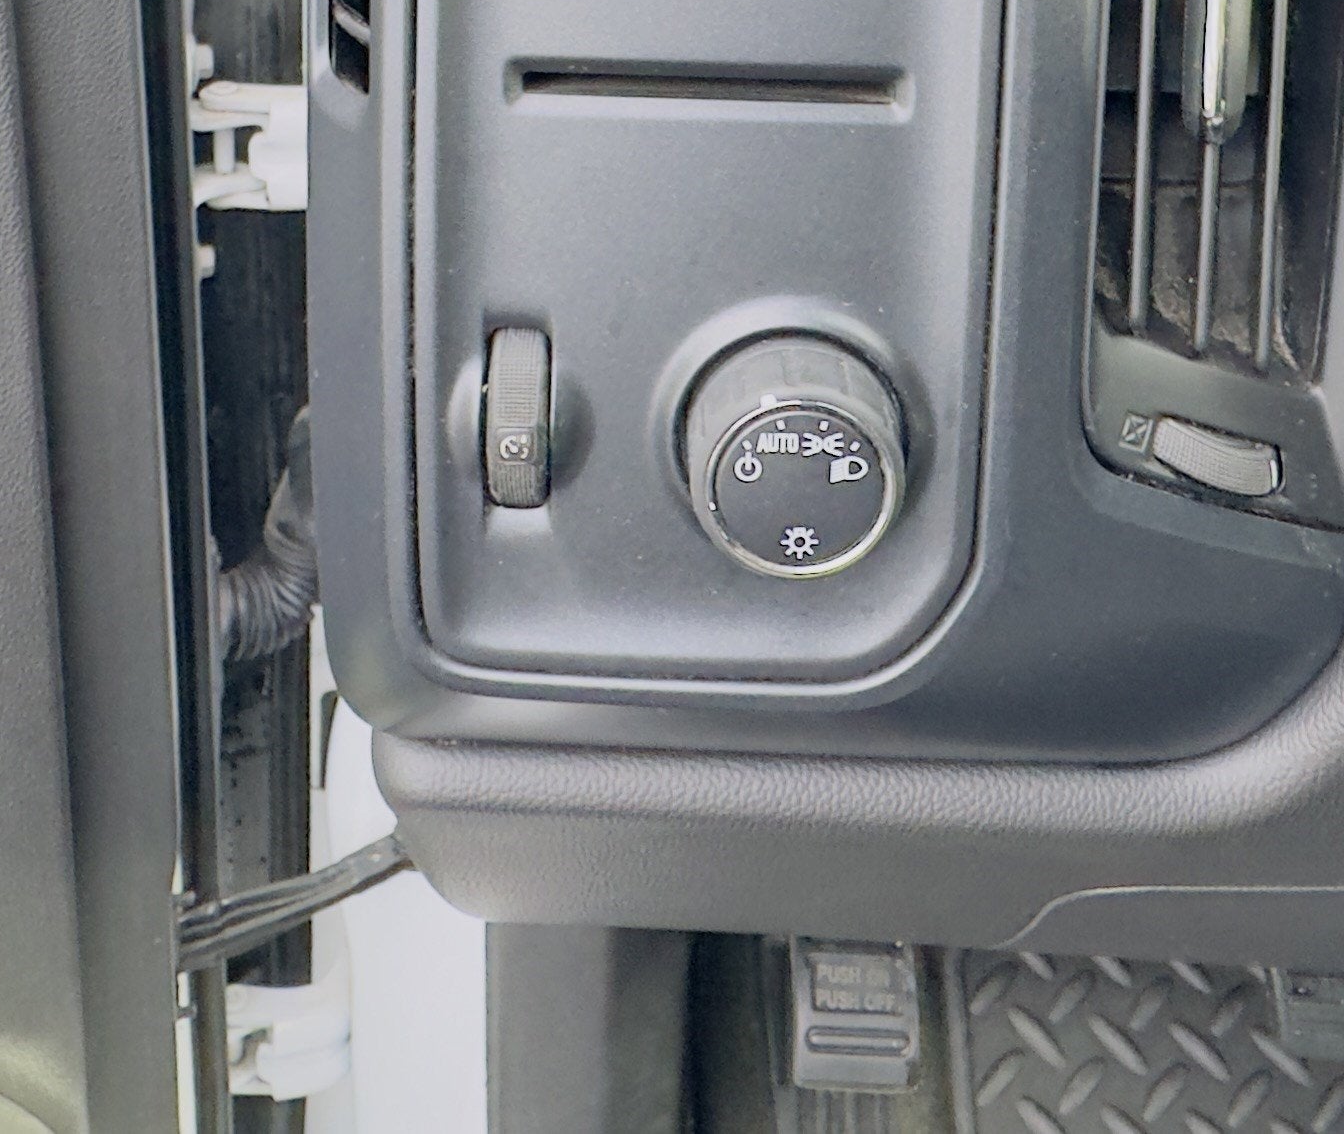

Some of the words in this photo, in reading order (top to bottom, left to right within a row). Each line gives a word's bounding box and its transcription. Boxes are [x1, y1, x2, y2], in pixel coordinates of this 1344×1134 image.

[756, 432, 799, 454] AUTO
[815, 963, 861, 984] PUSH
[815, 987, 860, 1010] PUSH
